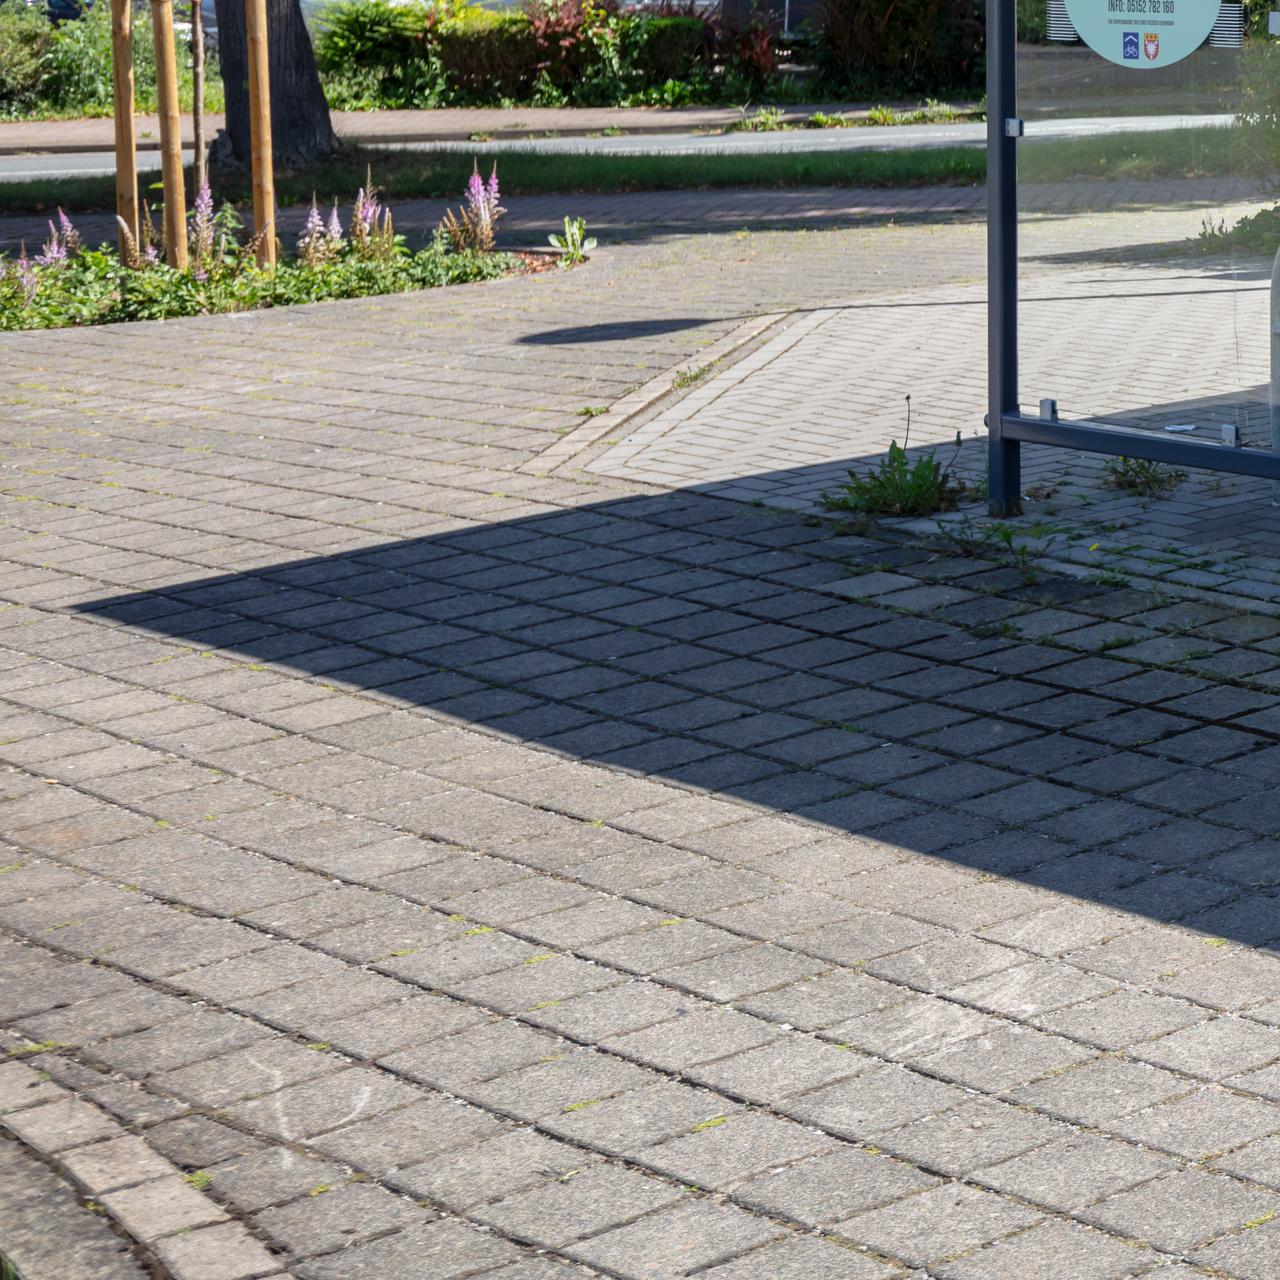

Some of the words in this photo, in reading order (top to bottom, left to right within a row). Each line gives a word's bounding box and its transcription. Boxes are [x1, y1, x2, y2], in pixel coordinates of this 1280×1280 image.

[1108, 0, 1125, 13] INFO:
[1126, 0, 1147, 13] 05152
[1148, 0, 1161, 14] 782
[1163, 0, 1175, 14] 160
